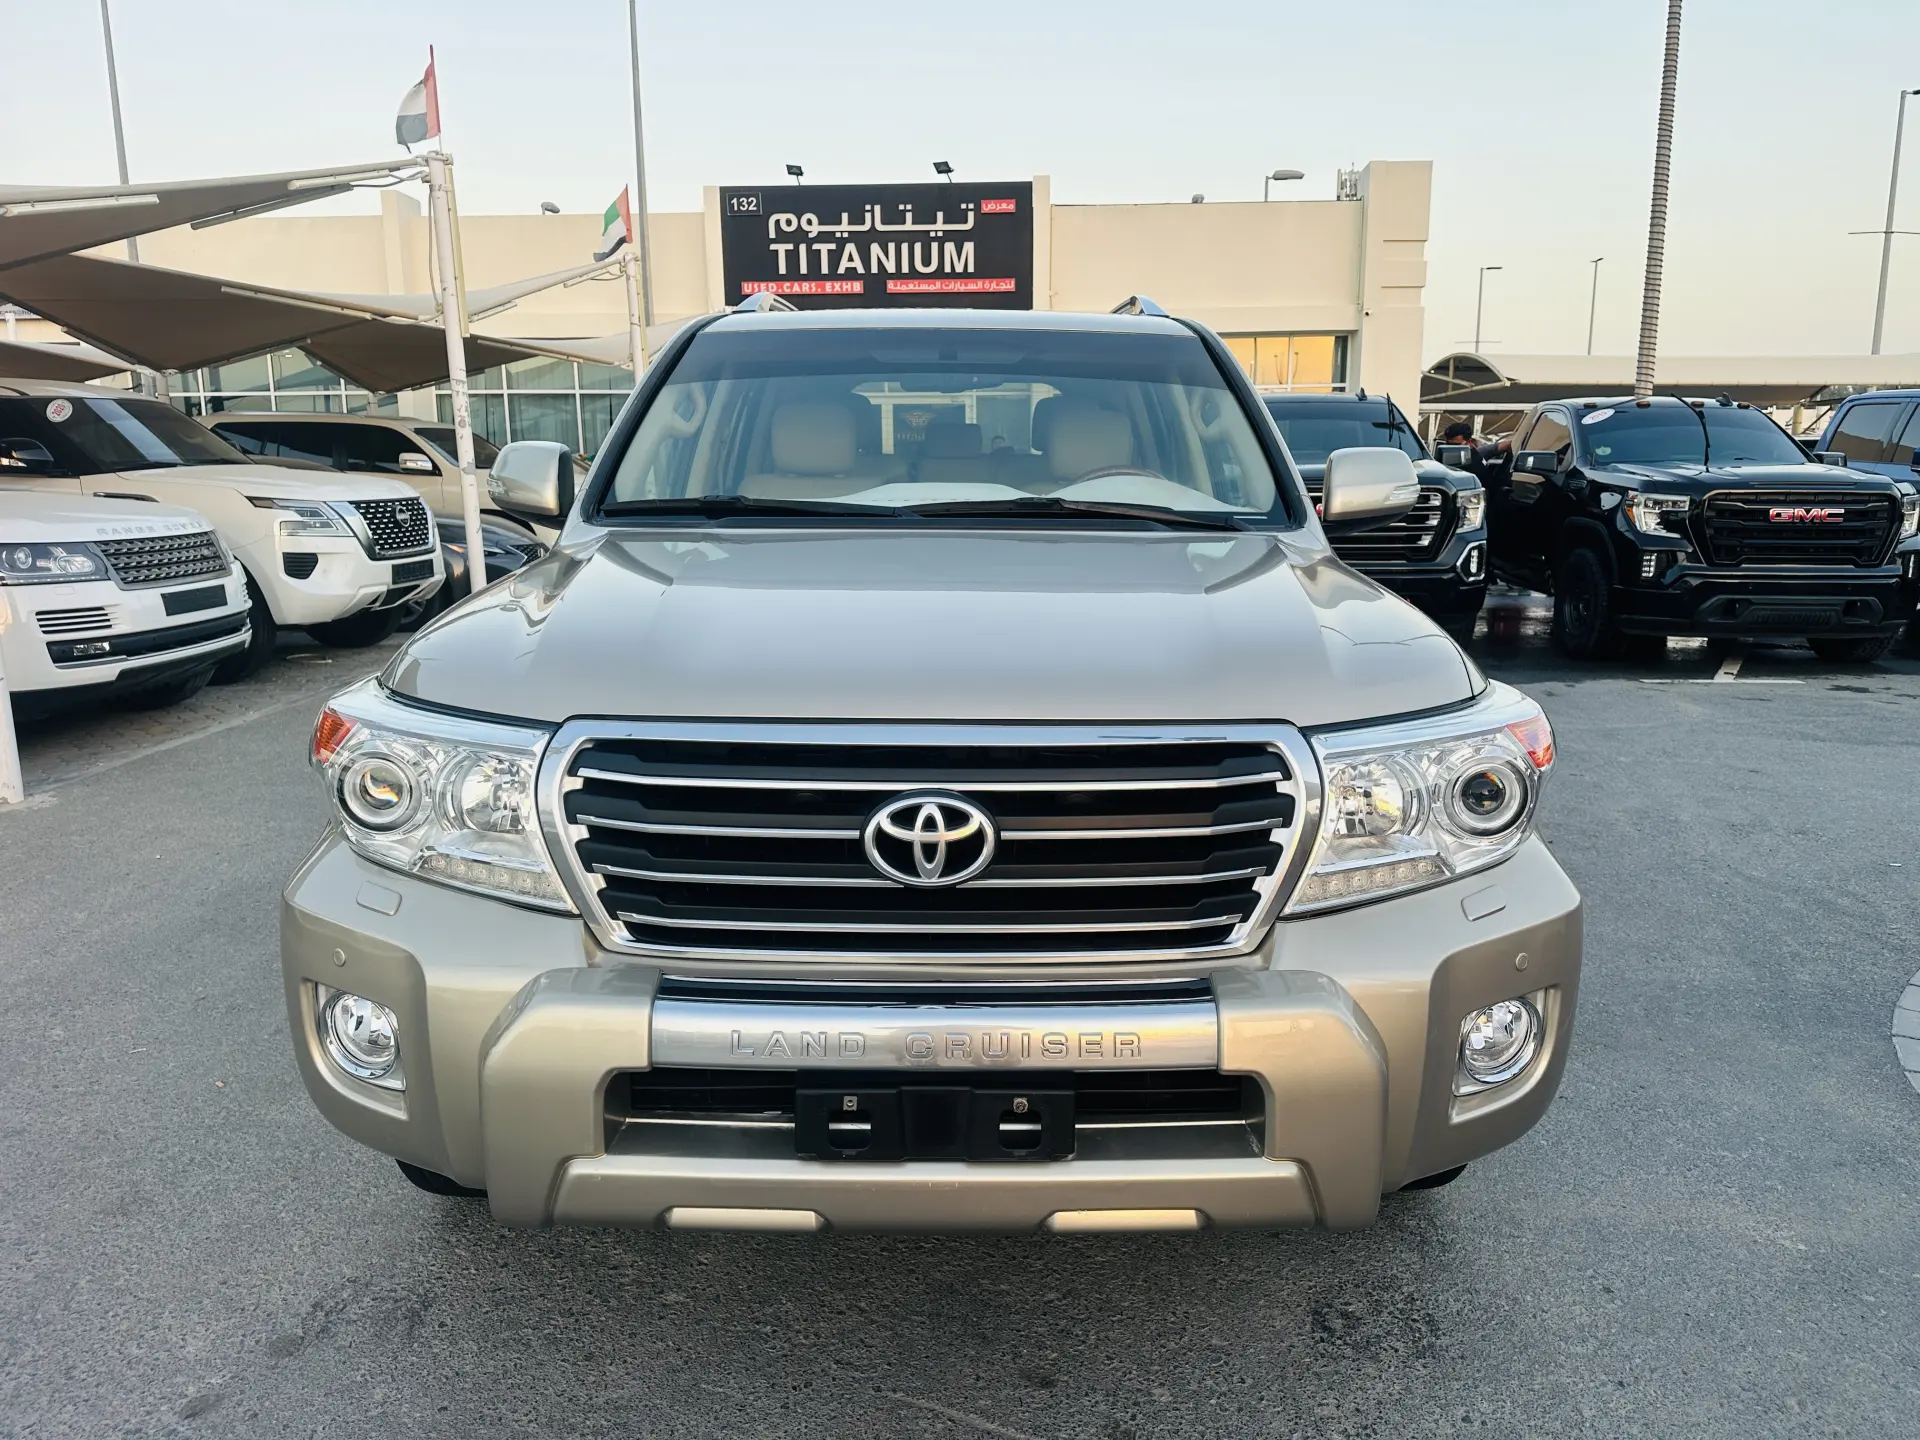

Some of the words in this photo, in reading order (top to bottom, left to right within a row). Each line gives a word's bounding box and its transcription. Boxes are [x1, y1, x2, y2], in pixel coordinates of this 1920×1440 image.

[730, 197, 758, 211] 132
[982, 200, 1014, 211] معرض
[768, 203, 975, 239] تيتانيوم
[769, 241, 975, 275] TITANIUM
[825, 281, 861, 292] EXHB
[888, 280, 941, 291] المستعملة
[942, 280, 983, 291] السيارات
[1769, 508, 1845, 523] GMC
[96, 525, 157, 536] RANGE
[730, 1029, 866, 1059] LAND
[905, 1031, 1142, 1060] CRUISER
